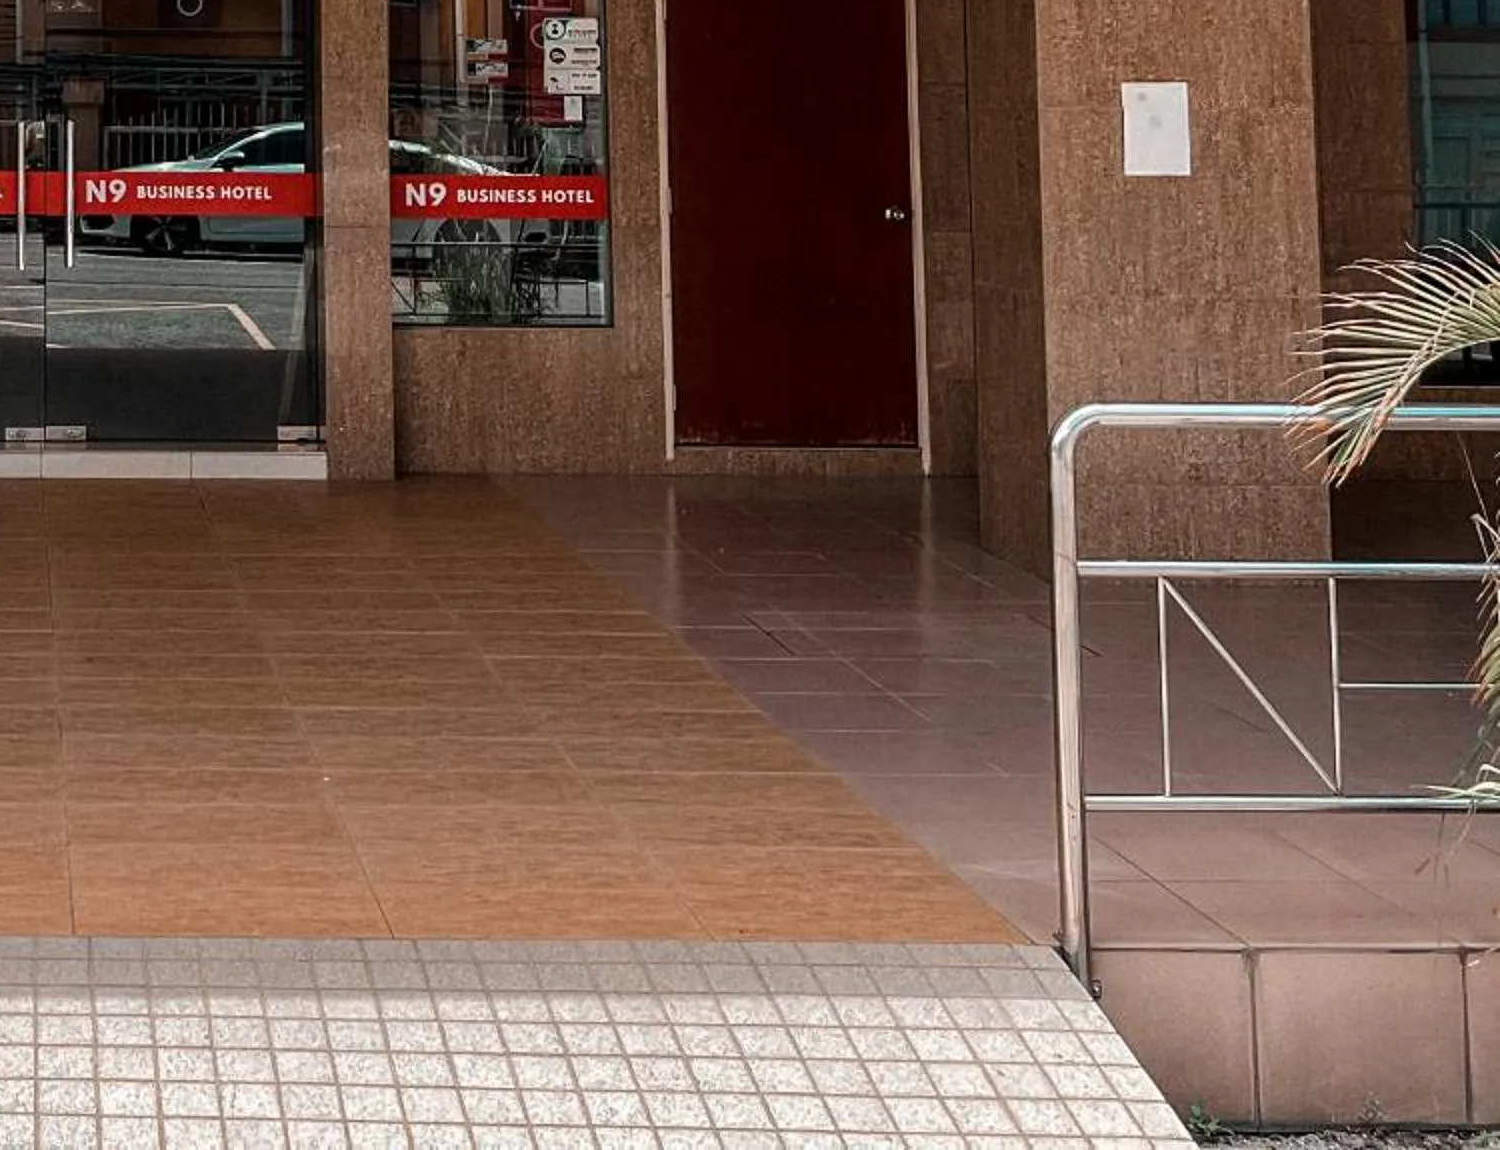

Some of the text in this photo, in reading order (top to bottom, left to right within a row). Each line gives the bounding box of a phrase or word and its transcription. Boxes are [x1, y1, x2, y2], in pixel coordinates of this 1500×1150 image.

[85, 179, 273, 203] N9 BUSINESS HOTEL
[405, 182, 594, 207] N9 BUSINESS HOTEL
